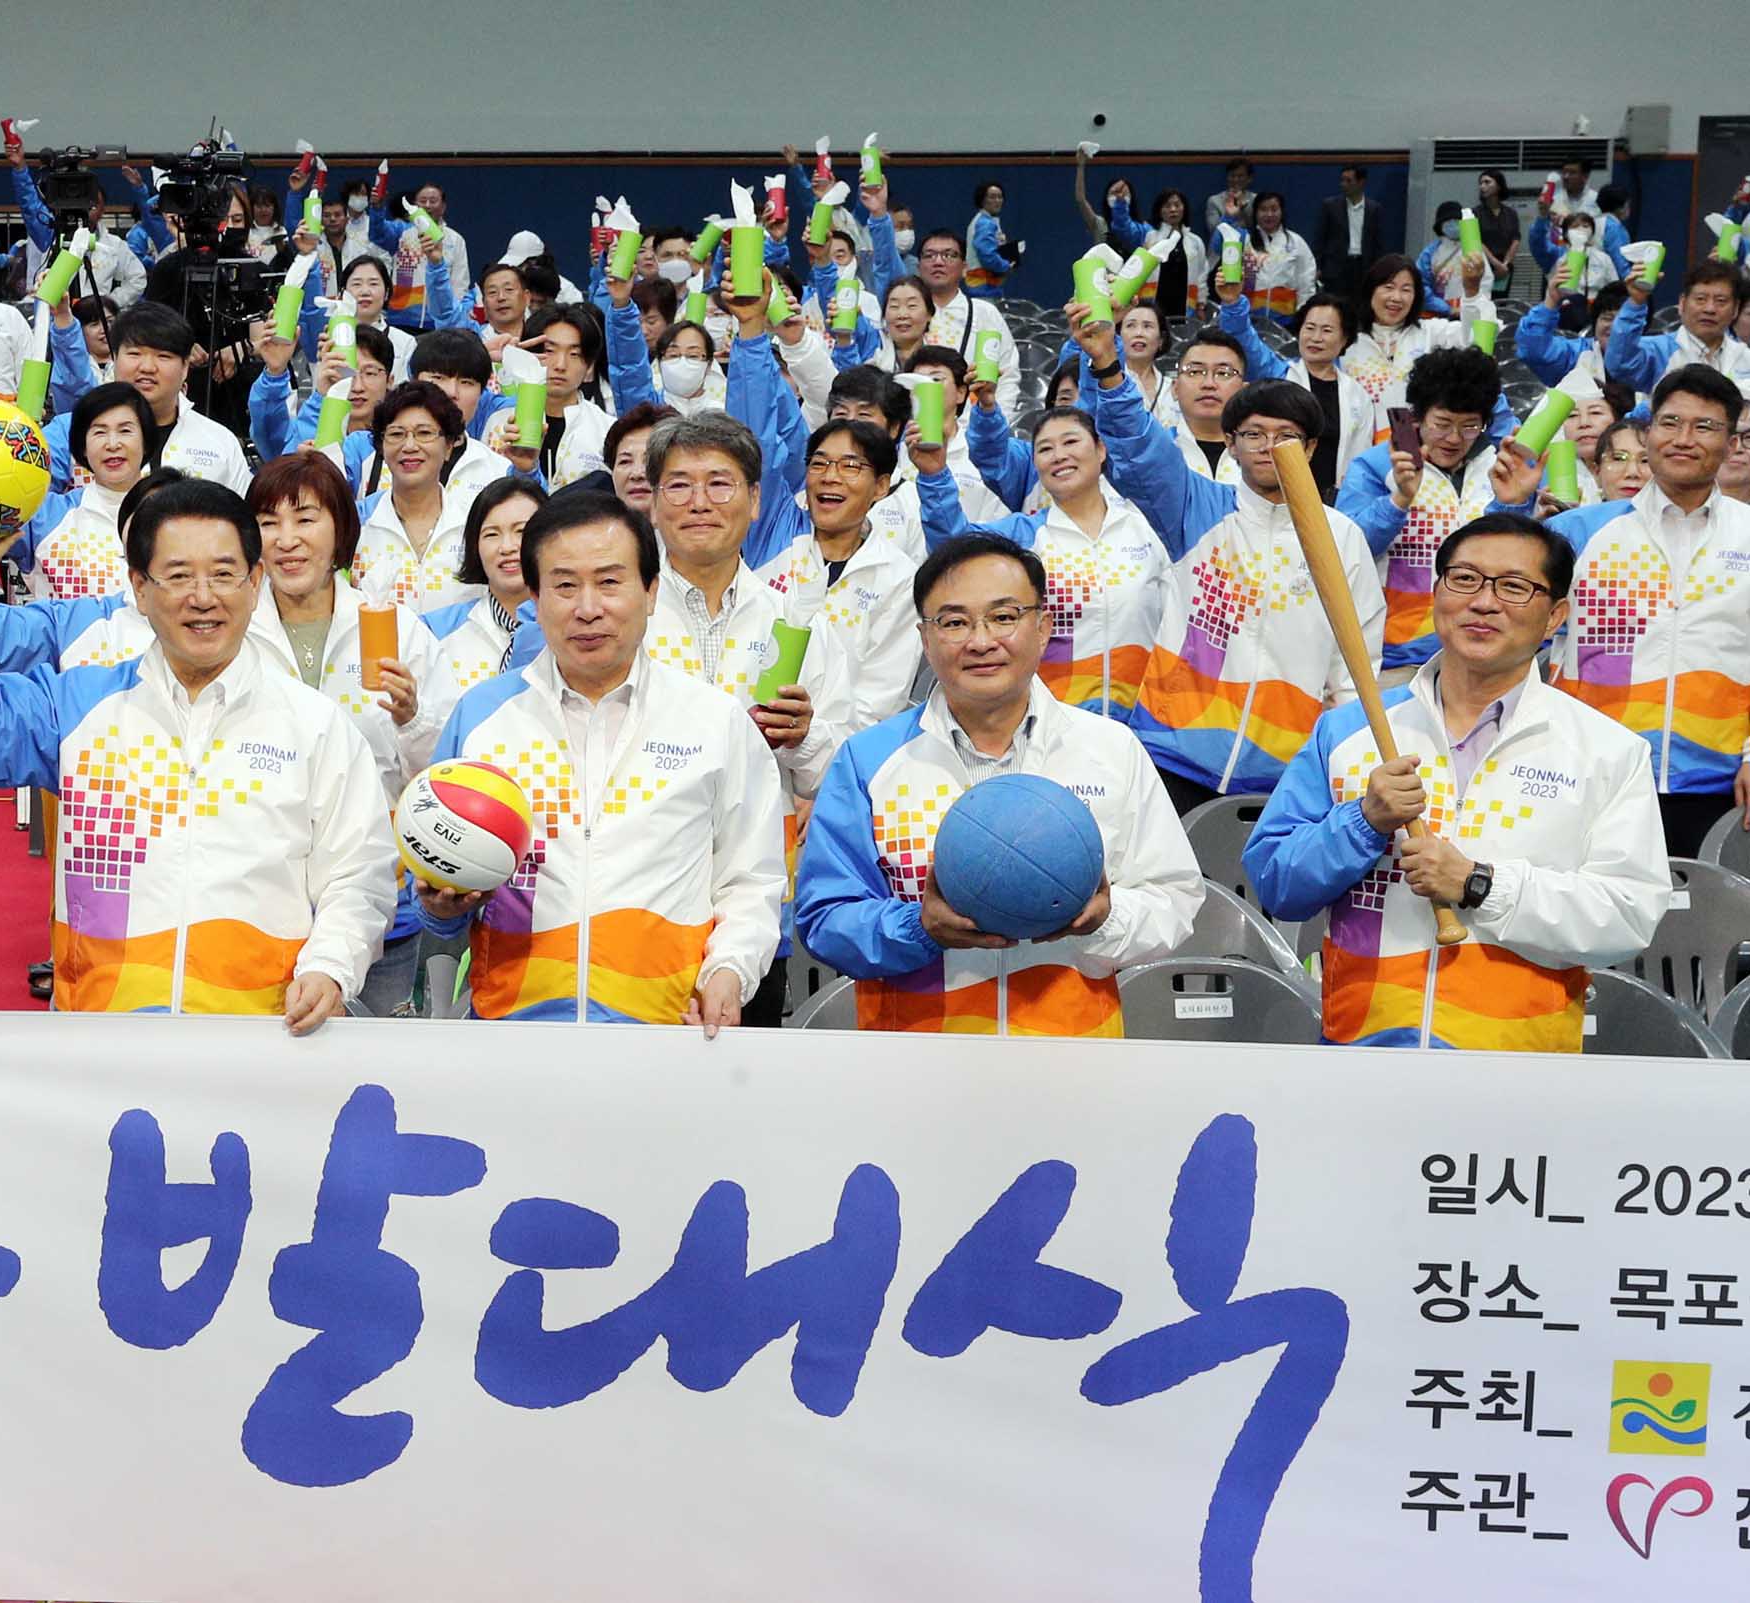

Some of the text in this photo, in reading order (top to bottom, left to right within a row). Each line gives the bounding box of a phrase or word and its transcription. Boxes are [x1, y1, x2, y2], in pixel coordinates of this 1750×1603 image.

[237, 742, 297, 761] JEONNAM
[642, 740, 703, 757] JEONNAM
[249, 757, 282, 774] 2023
[1510, 764, 1577, 789] JEONNAM
[1521, 781, 1559, 799] 2023
[99, 1086, 1349, 1603] 발대식
